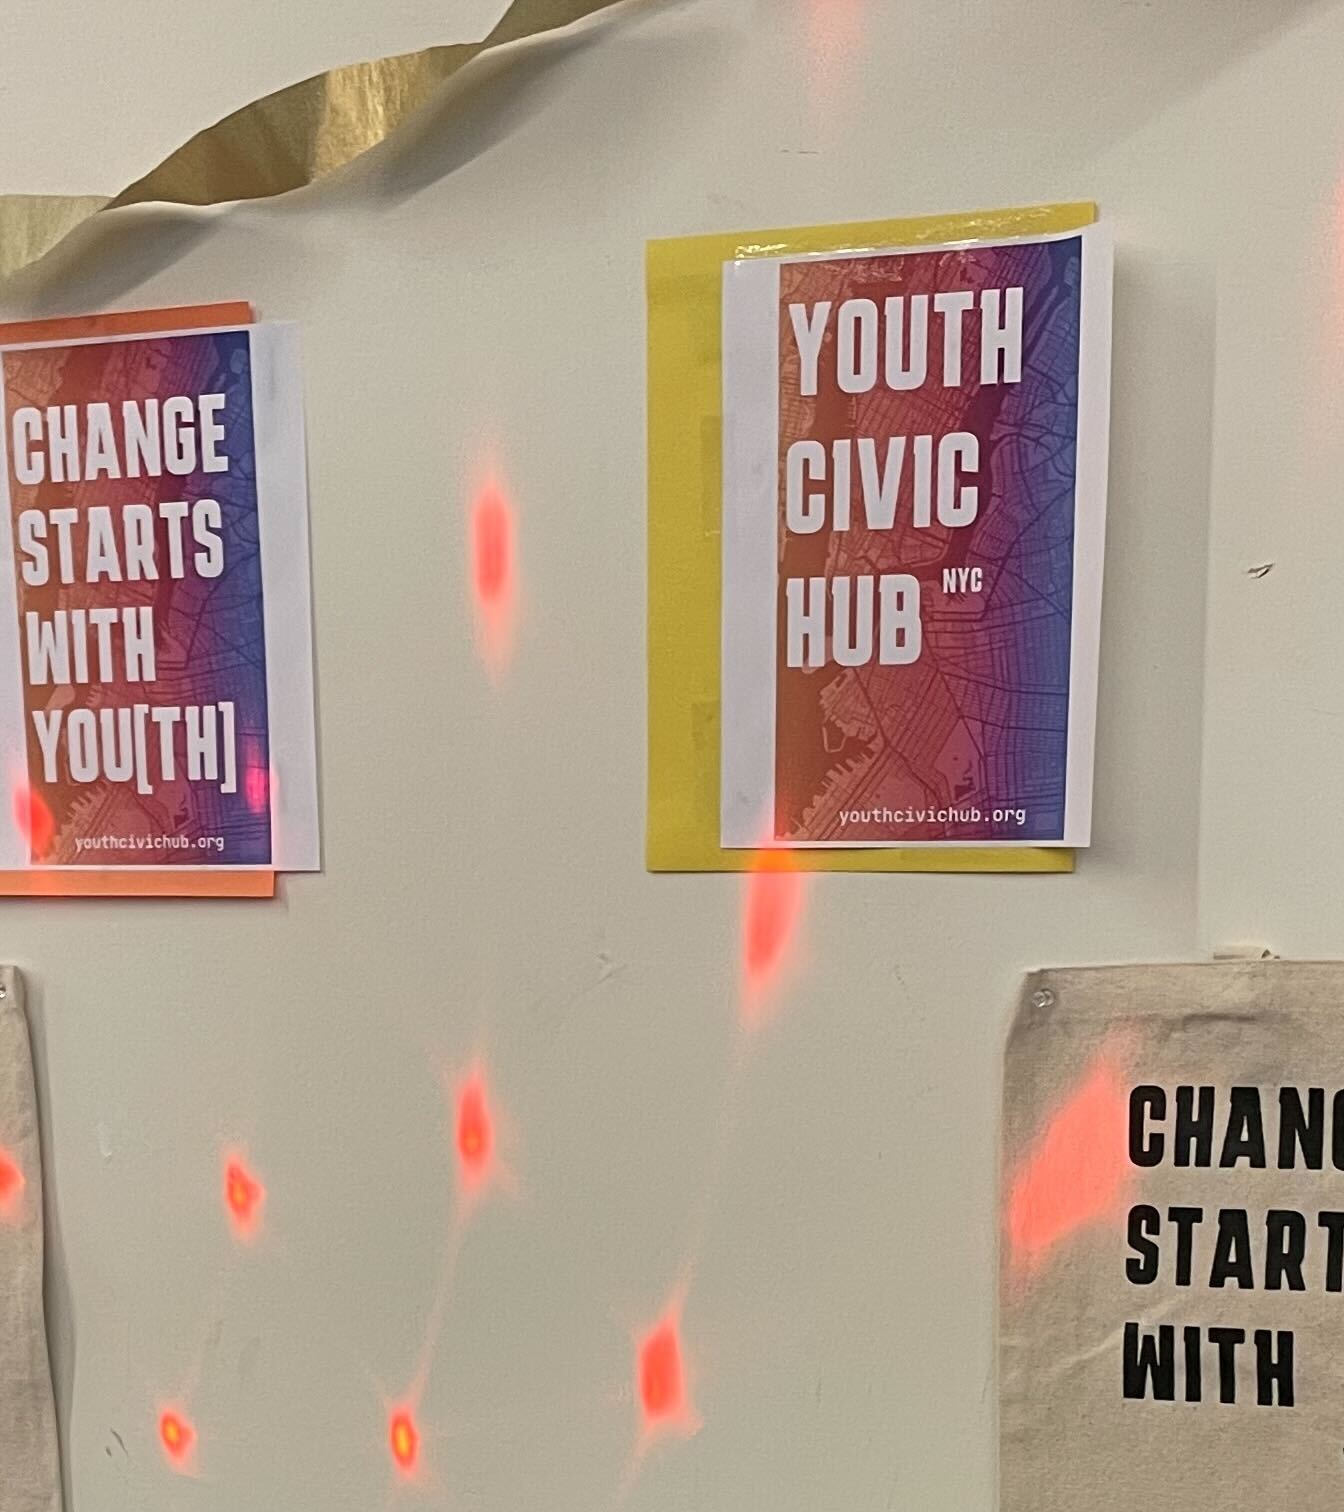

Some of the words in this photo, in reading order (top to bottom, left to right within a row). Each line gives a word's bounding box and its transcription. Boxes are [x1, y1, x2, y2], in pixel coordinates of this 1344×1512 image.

[788, 287, 1023, 396] YOUTH
[12, 394, 229, 484] CHANGE
[786, 432, 979, 535] CIVIC
[19, 500, 223, 586] STARTS
[26, 607, 157, 684] WITH
[786, 574, 922, 668] HUB
[942, 568, 983, 594] NYC
[33, 702, 236, 794] YOU[TH]
[75, 834, 225, 852] youthcivichub.org
[839, 806, 1026, 827] youthcivichub.org
[1122, 1321, 1296, 1408] WITH
